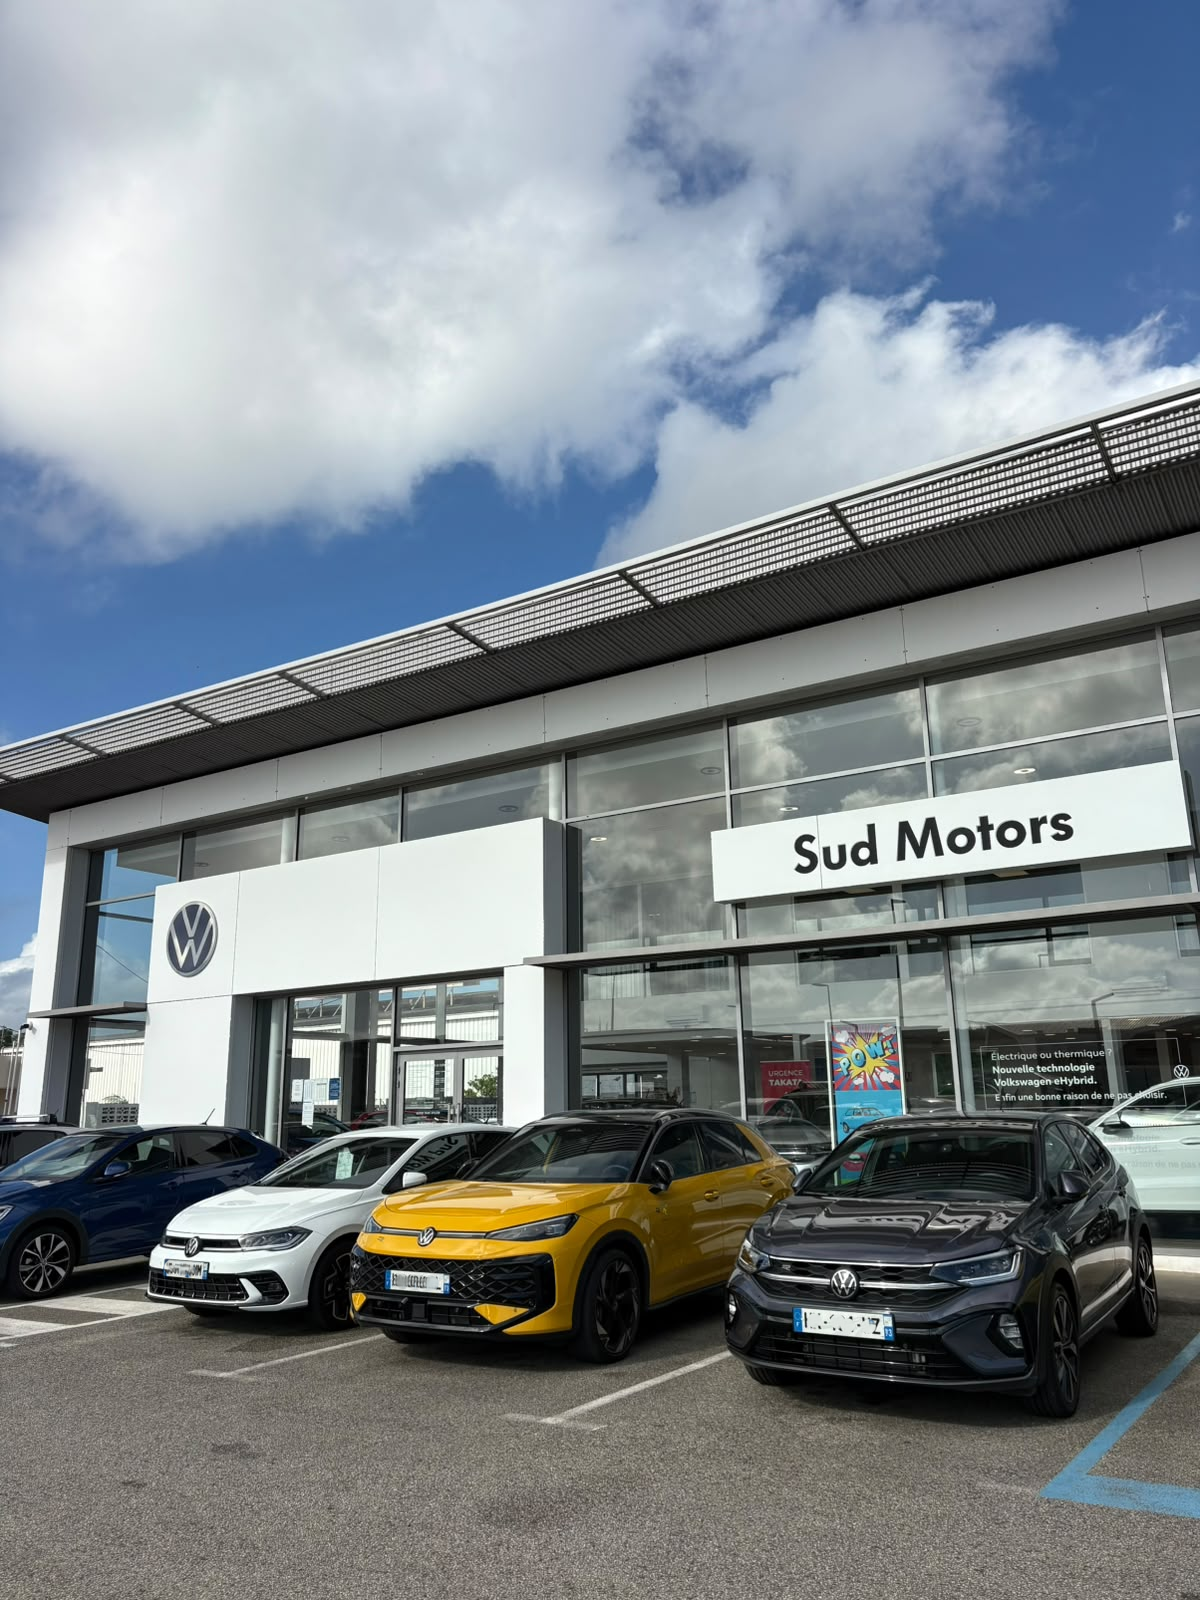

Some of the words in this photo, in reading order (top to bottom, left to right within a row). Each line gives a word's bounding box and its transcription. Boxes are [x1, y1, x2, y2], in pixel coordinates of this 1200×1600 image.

[794, 823, 878, 874] Sud
[896, 812, 1074, 863] Motors
[839, 1039, 896, 1077] POW!
[991, 1050, 1038, 1062] Électrique
[1039, 1051, 1052, 1060] ou
[1054, 1049, 1105, 1060] thermique
[1106, 1048, 1113, 1057] ?
[768, 1069, 804, 1077] URGENCE
[992, 1064, 1035, 1074] Nouvelle
[1036, 1062, 1096, 1074] technologie
[993, 1077, 1052, 1088] Volkswagen
[1053, 1075, 1098, 1087] eHybrid.
[1017, 1093, 1034, 1101] une
[1034, 1092, 1062, 1101] bonne
[1063, 1091, 1090, 1100] raison
[1090, 1090, 1103, 1100] de
[1103, 1092, 1116, 1100] ne
[1117, 1092, 1133, 1101] pas
